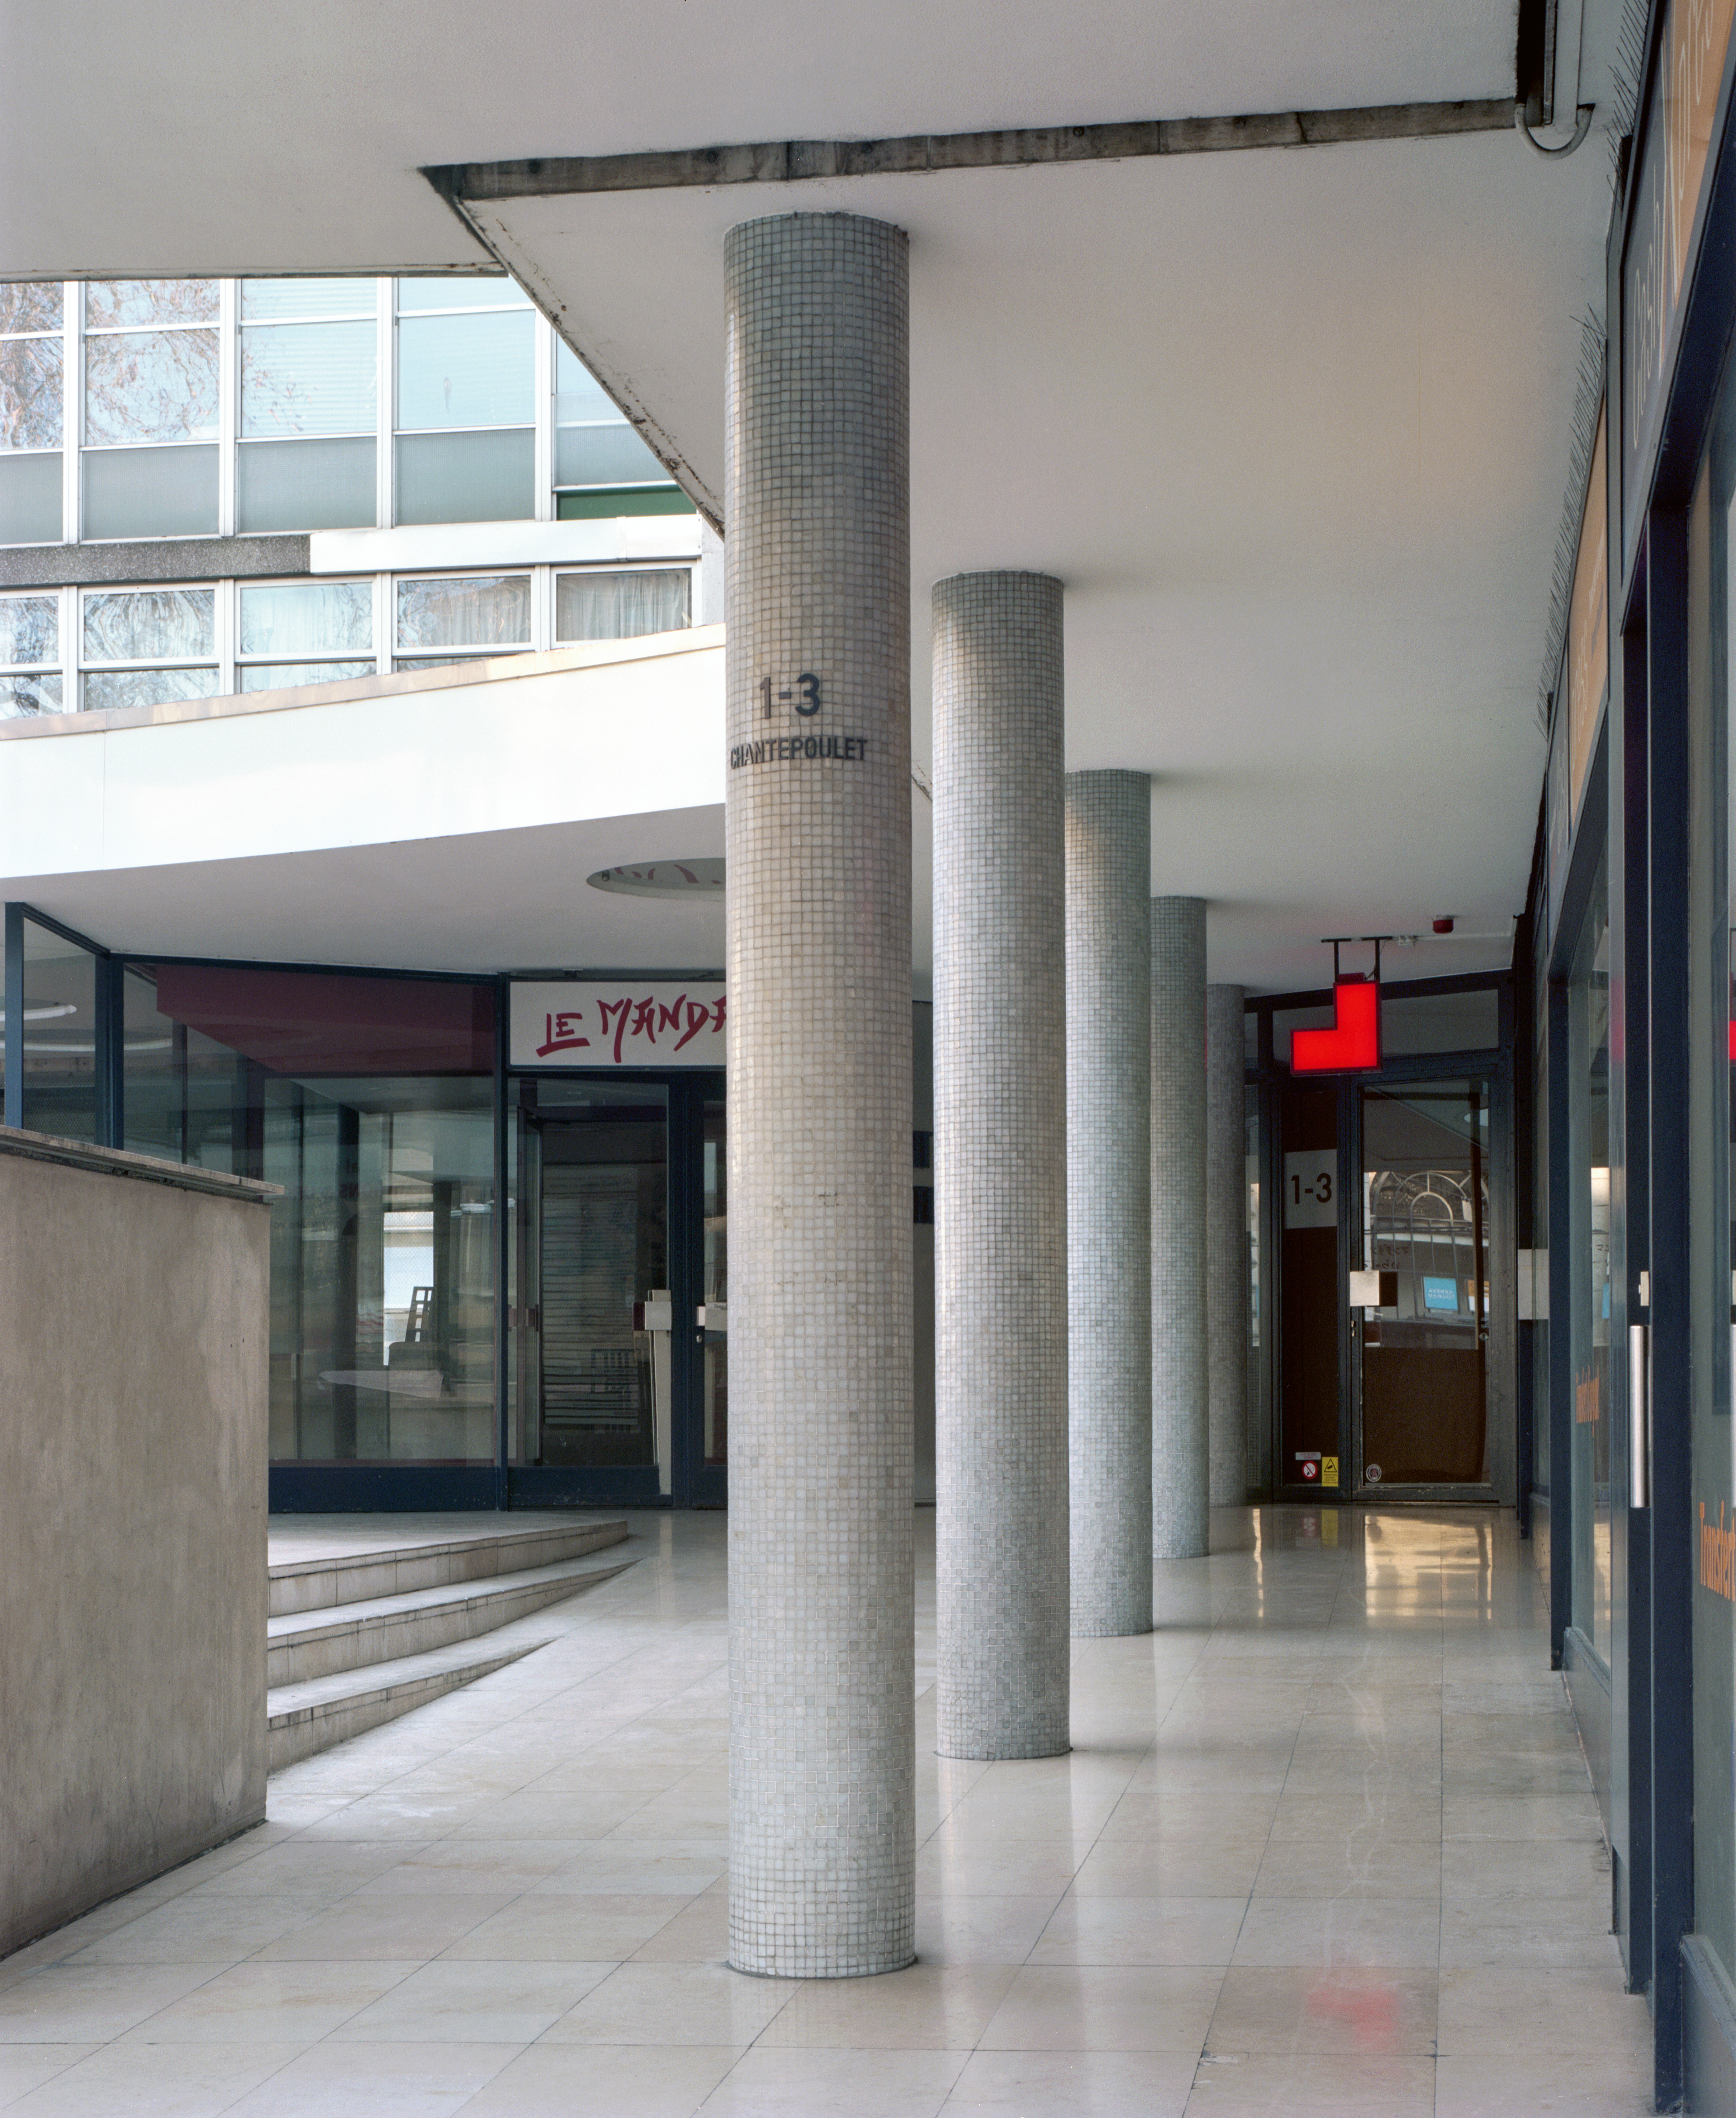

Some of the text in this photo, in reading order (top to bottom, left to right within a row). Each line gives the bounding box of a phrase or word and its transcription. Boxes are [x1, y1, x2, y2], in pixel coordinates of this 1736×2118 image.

[759, 673, 820, 719] 1-3
[730, 737, 867, 769] CHANTEPOULET
[536, 1012, 590, 1057] LE
[1291, 1173, 1332, 1204] 1-3
